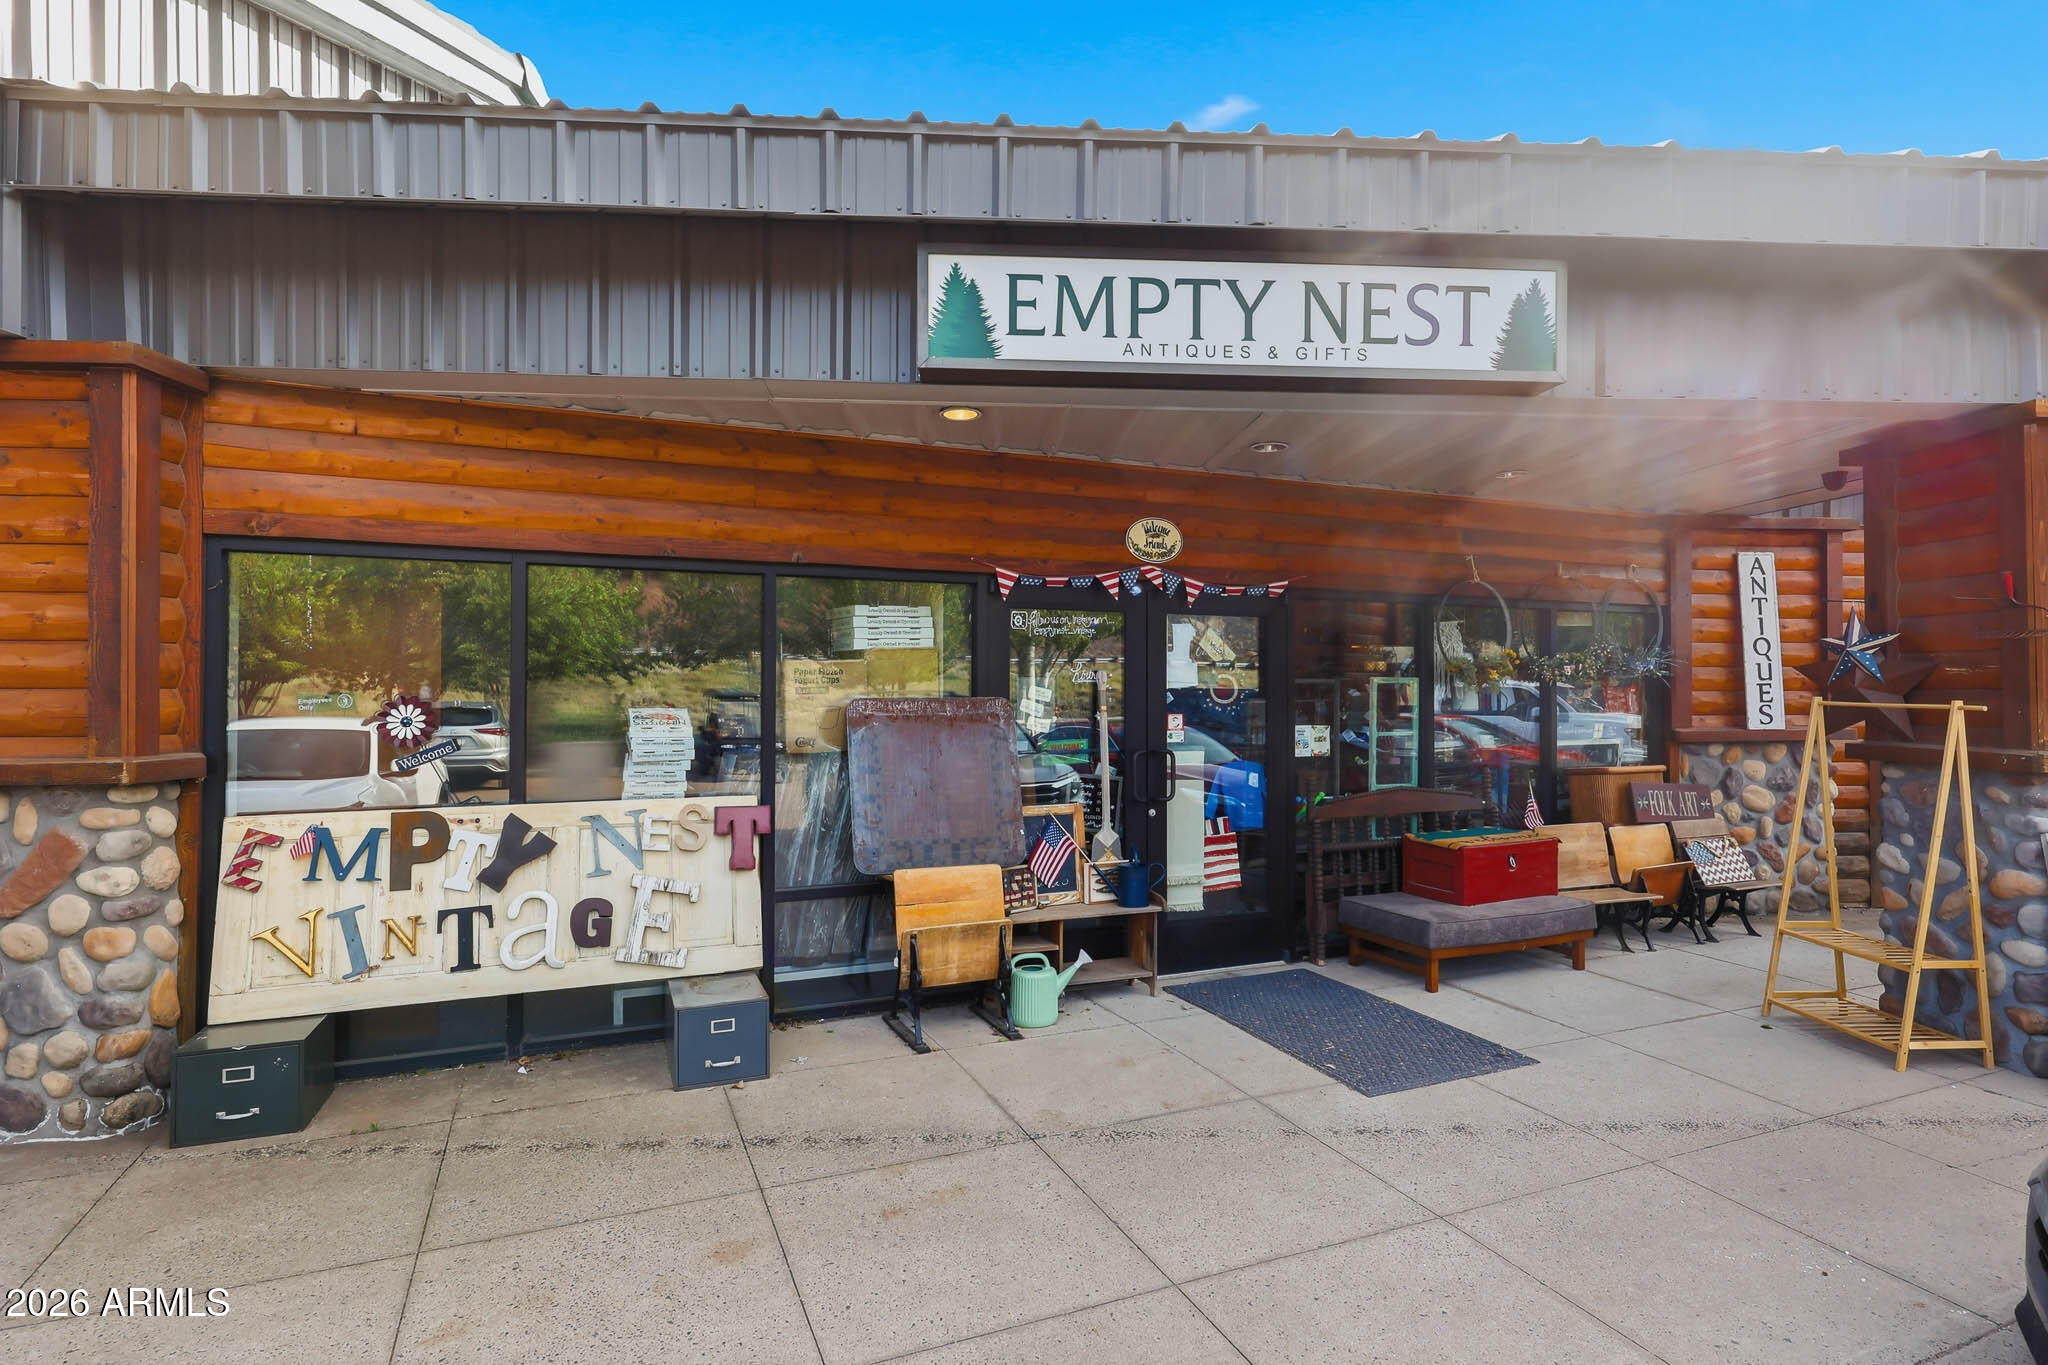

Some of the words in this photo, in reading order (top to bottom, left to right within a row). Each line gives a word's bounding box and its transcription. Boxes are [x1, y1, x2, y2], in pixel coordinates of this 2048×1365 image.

[1005, 272, 1277, 342] EMPTY
[1301, 280, 1491, 348] NEST
[1122, 342, 1252, 362] ANTIQUES
[1267, 347, 1280, 361] &
[1295, 346, 1369, 362] GIFTS
[1750, 556, 1774, 725] ANTIQUES
[793, 667, 816, 677] Paper
[821, 676, 840, 685] Cups
[398, 745, 454, 769] Welcome
[1648, 789, 1678, 817] FOLK
[1679, 791, 1699, 817] ART
[222, 810, 558, 894] EMPTY
[580, 803, 772, 878] NEST
